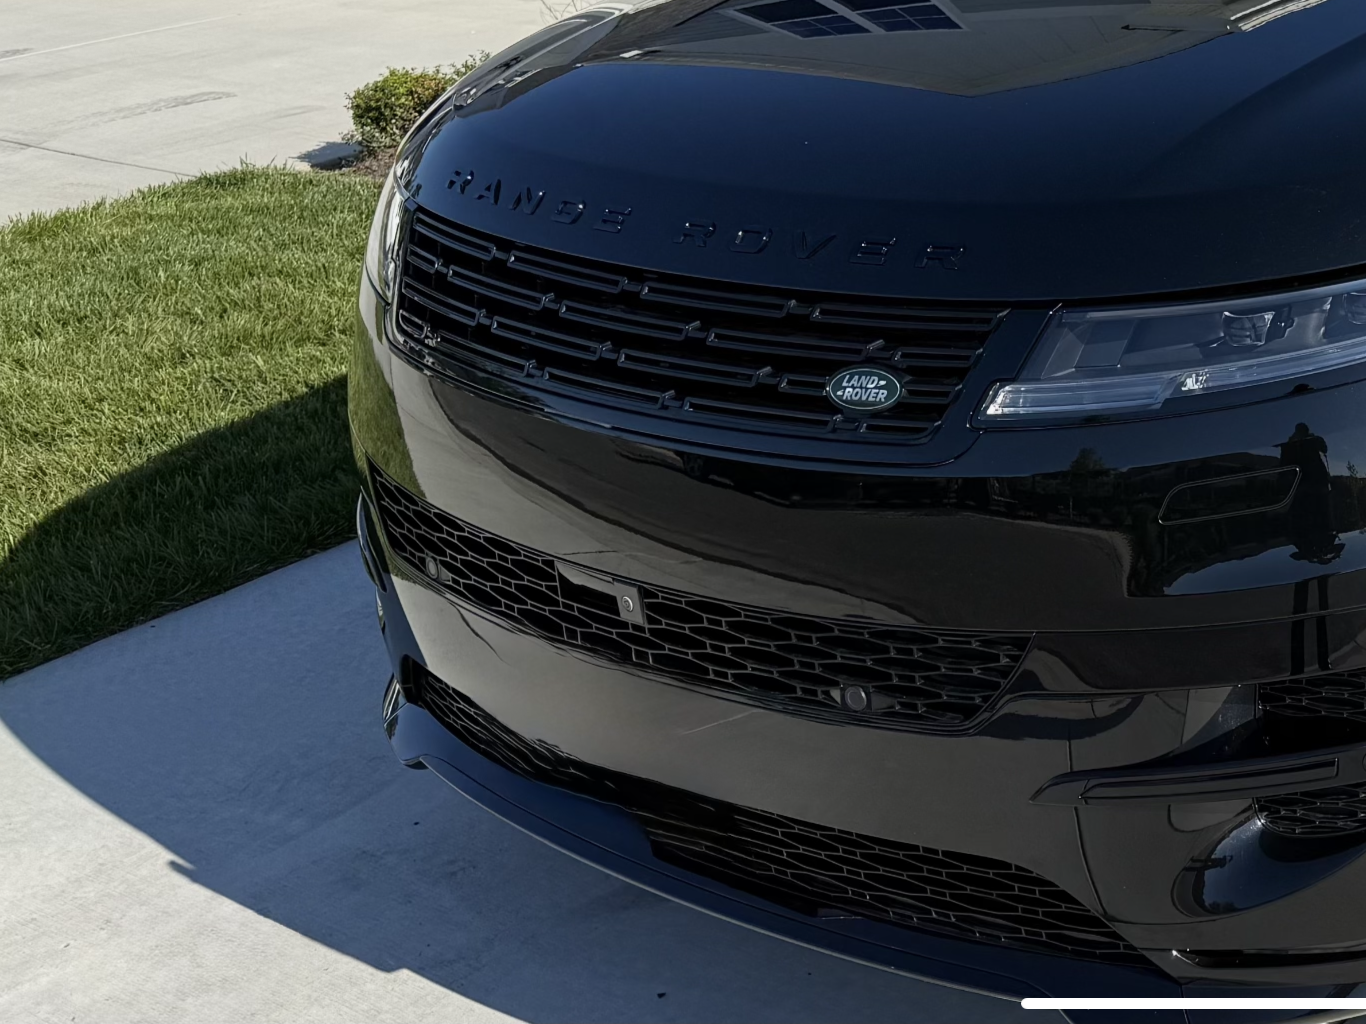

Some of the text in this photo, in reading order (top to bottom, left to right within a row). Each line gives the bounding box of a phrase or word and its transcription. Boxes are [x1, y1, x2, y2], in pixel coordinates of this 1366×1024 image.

[446, 169, 967, 272] RANGE ROVER
[841, 374, 879, 388] LAND
[842, 387, 888, 403] ROVER
